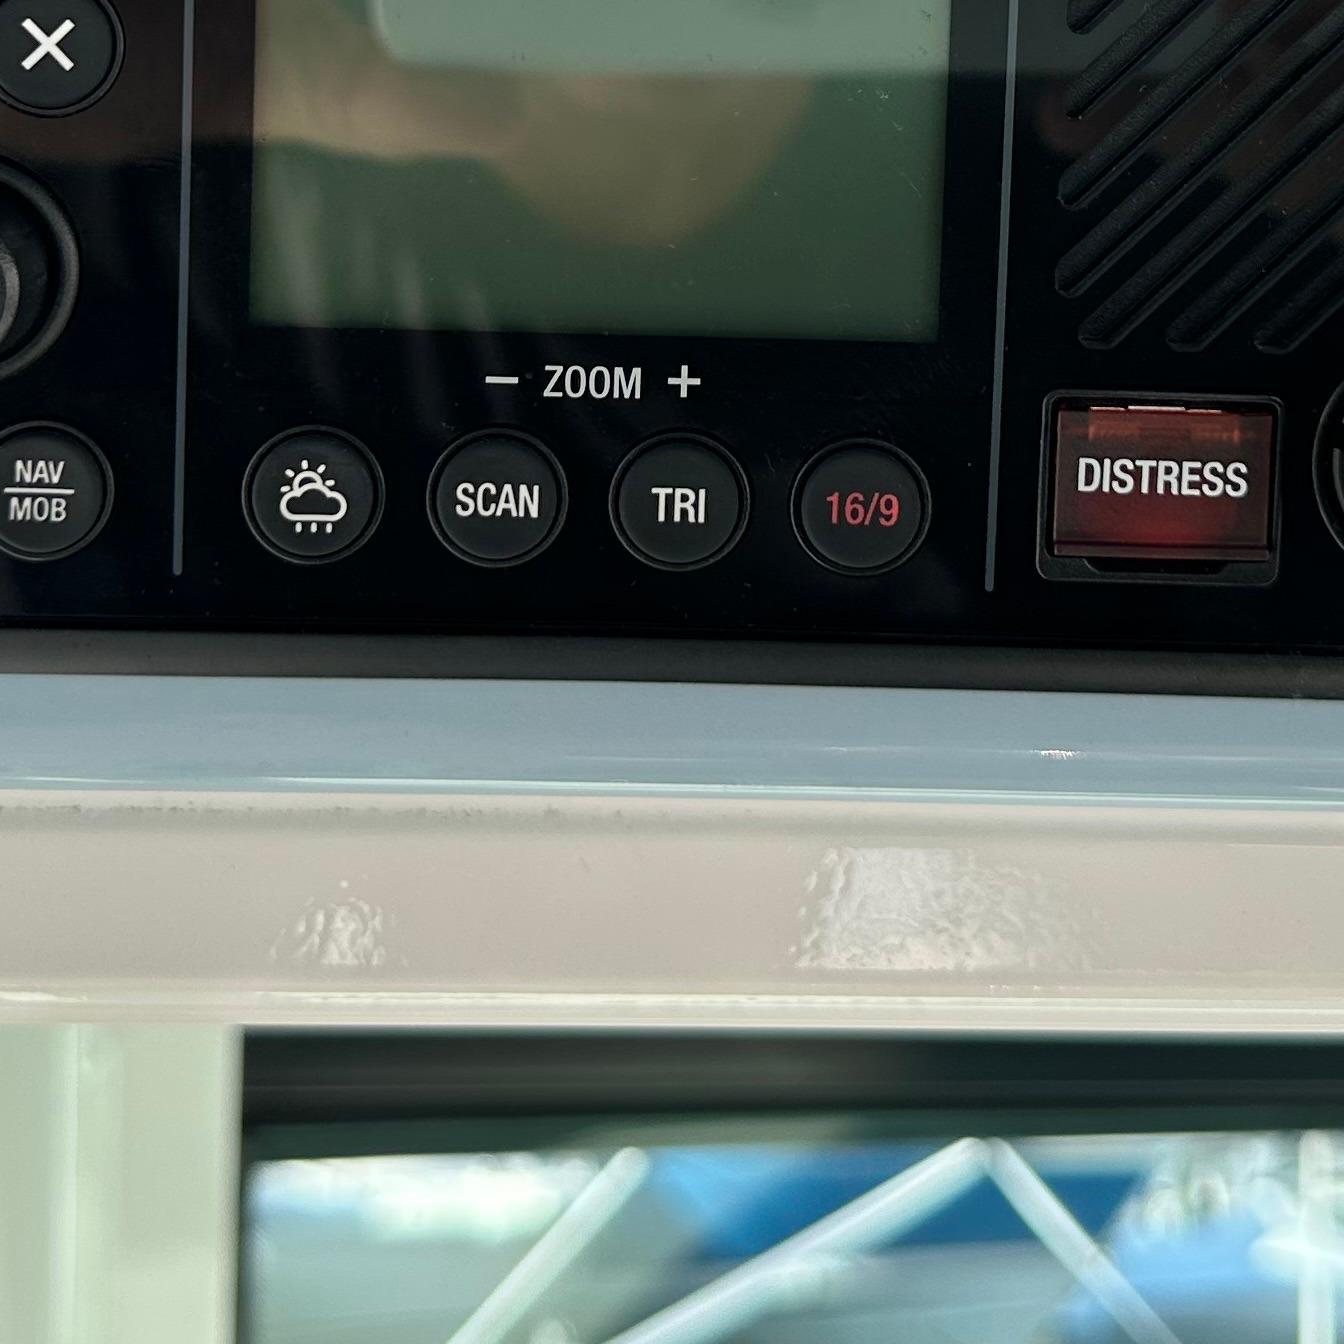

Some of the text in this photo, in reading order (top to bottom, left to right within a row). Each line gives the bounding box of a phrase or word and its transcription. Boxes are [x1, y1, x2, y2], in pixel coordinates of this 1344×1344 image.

[542, 364, 642, 400] ZOOM
[14, 459, 66, 485] NAV
[1076, 457, 1249, 499] DISTRESS
[8, 496, 68, 523] MOB
[455, 482, 540, 519] SCAN
[650, 487, 706, 524] TRI
[826, 492, 900, 527] 16/9
